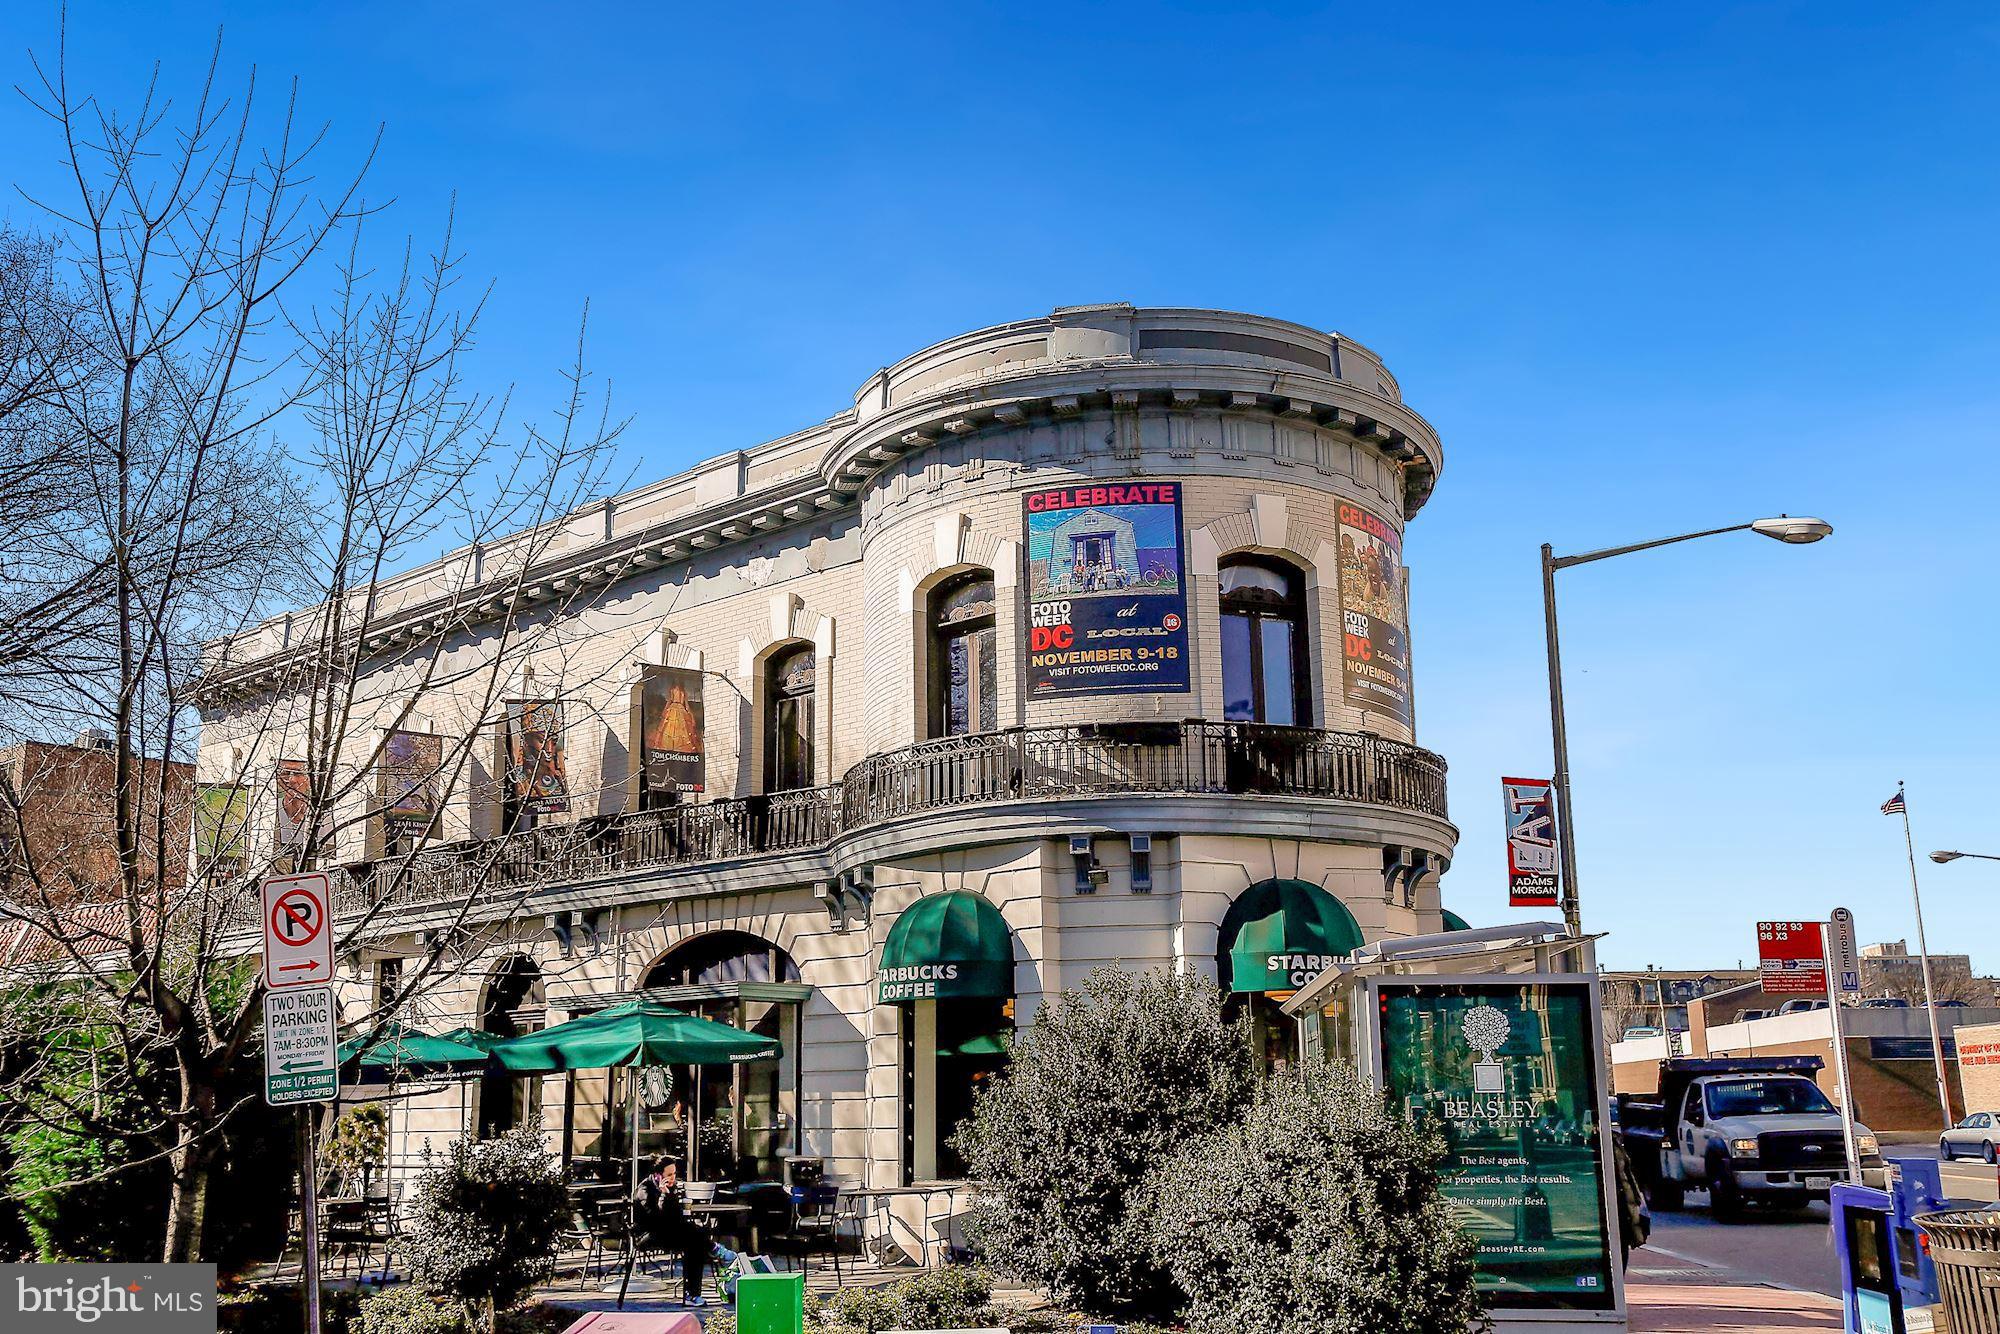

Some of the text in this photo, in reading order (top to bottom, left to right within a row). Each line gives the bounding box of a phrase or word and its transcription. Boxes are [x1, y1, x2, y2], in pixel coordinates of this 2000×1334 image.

[1028, 485, 1174, 512] CELEBRATE
[1030, 601, 1071, 616] FOTO
[1116, 603, 1138, 617] at
[1031, 613, 1071, 628] WEEK
[1344, 610, 1368, 627] FOTO
[1031, 625, 1074, 652] DC
[1087, 627, 1168, 638] LOCAL
[1345, 623, 1369, 639] WEEK
[1345, 634, 1372, 661] DC
[1032, 647, 1178, 667] NOVEMBER 9-18
[1049, 663, 1158, 677] VISIT FOTOWEEKDC.ORG
[1346, 660, 1395, 686] NOVEMBER
[1516, 878, 1554, 886] ADAMS
[1512, 886, 1556, 895] MORGAN
[1760, 932, 1788, 940] 96 X3
[1840, 923, 1850, 968] metrobus
[879, 965, 958, 982] TARBUCKS
[1842, 973, 1856, 986] M
[882, 982, 936, 999] COFFEE
[270, 993, 326, 1011] TWO HOUR
[272, 1009, 327, 1028] PARKING
[274, 1030, 288, 1038] LIMIT
[299, 1027, 314, 1035] ZONE
[274, 1036, 328, 1051] 7AM-8:30PM
[277, 1050, 325, 1060] MONDAY-FRIDAY
[271, 1075, 333, 1089] ZONE 1/2 PERMIT
[272, 1088, 333, 1101] HOLDERS EXCEPTED
[1443, 1100, 1540, 1118] BEASLEY
[1488, 1120, 1532, 1128] ESTATE
[1460, 1156, 1529, 1166] The Best agents,
[1455, 1175, 1502, 1185] properties,
[1504, 1175, 1519, 1183] the
[1521, 1175, 1538, 1183] Best
[1540, 1175, 1572, 1184] results.
[1450, 1197, 1546, 1207] Quite simply the Best.
